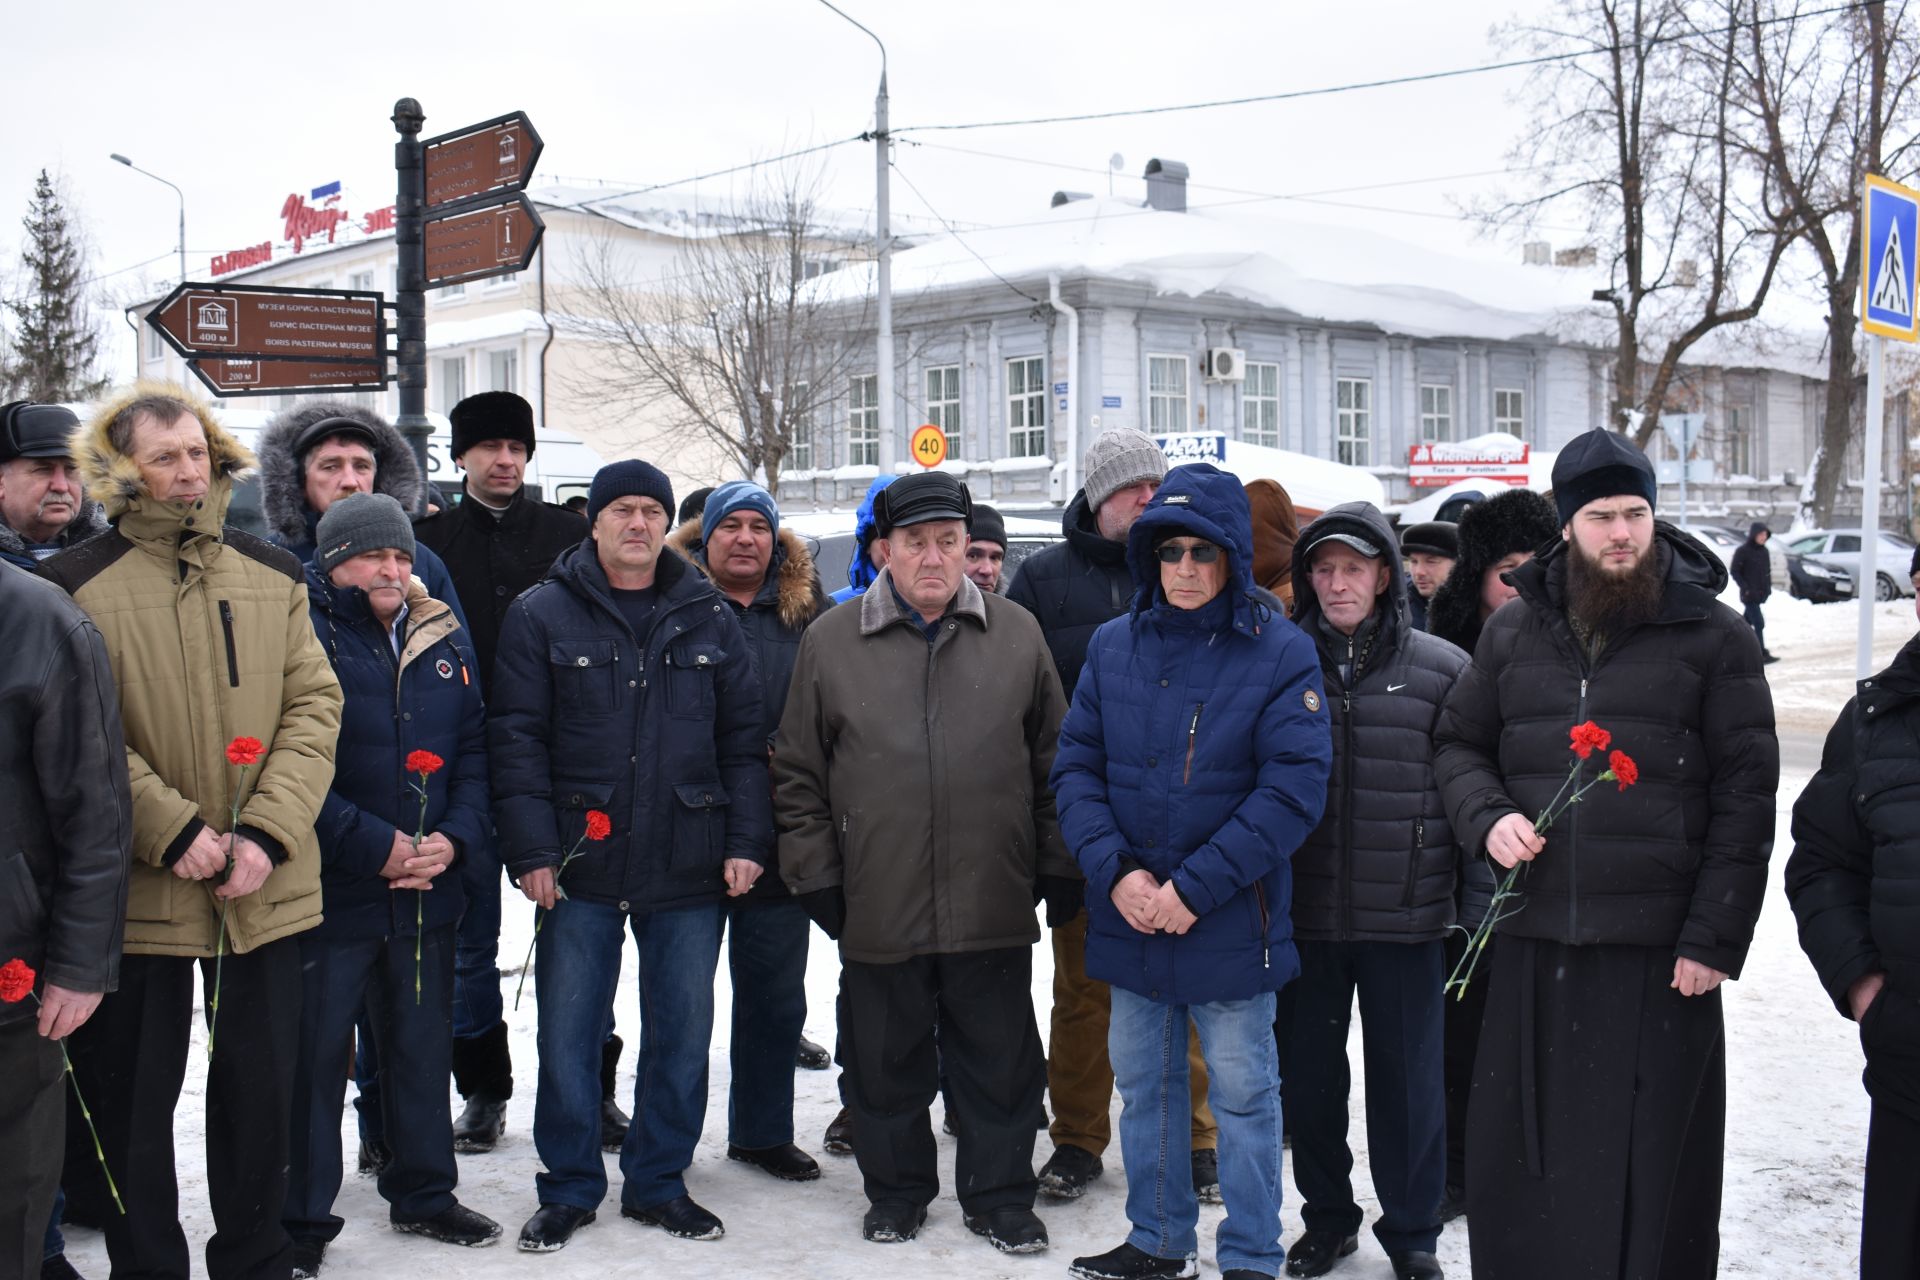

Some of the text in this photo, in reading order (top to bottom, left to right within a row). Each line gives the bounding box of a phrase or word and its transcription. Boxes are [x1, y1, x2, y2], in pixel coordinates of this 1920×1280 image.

[287, 304, 319, 313] БОРИСА
[321, 306, 372, 316] ПАСТЕРНАКА
[270, 321, 372, 333] БОРИС ПАСТЕРНАК МУЗЕЕ
[199, 333, 217, 342] 400
[265, 338, 373, 350] BORIS PASTERNAK MUSEUM
[228, 372, 243, 381] 200
[919, 438, 939, 454] 40
